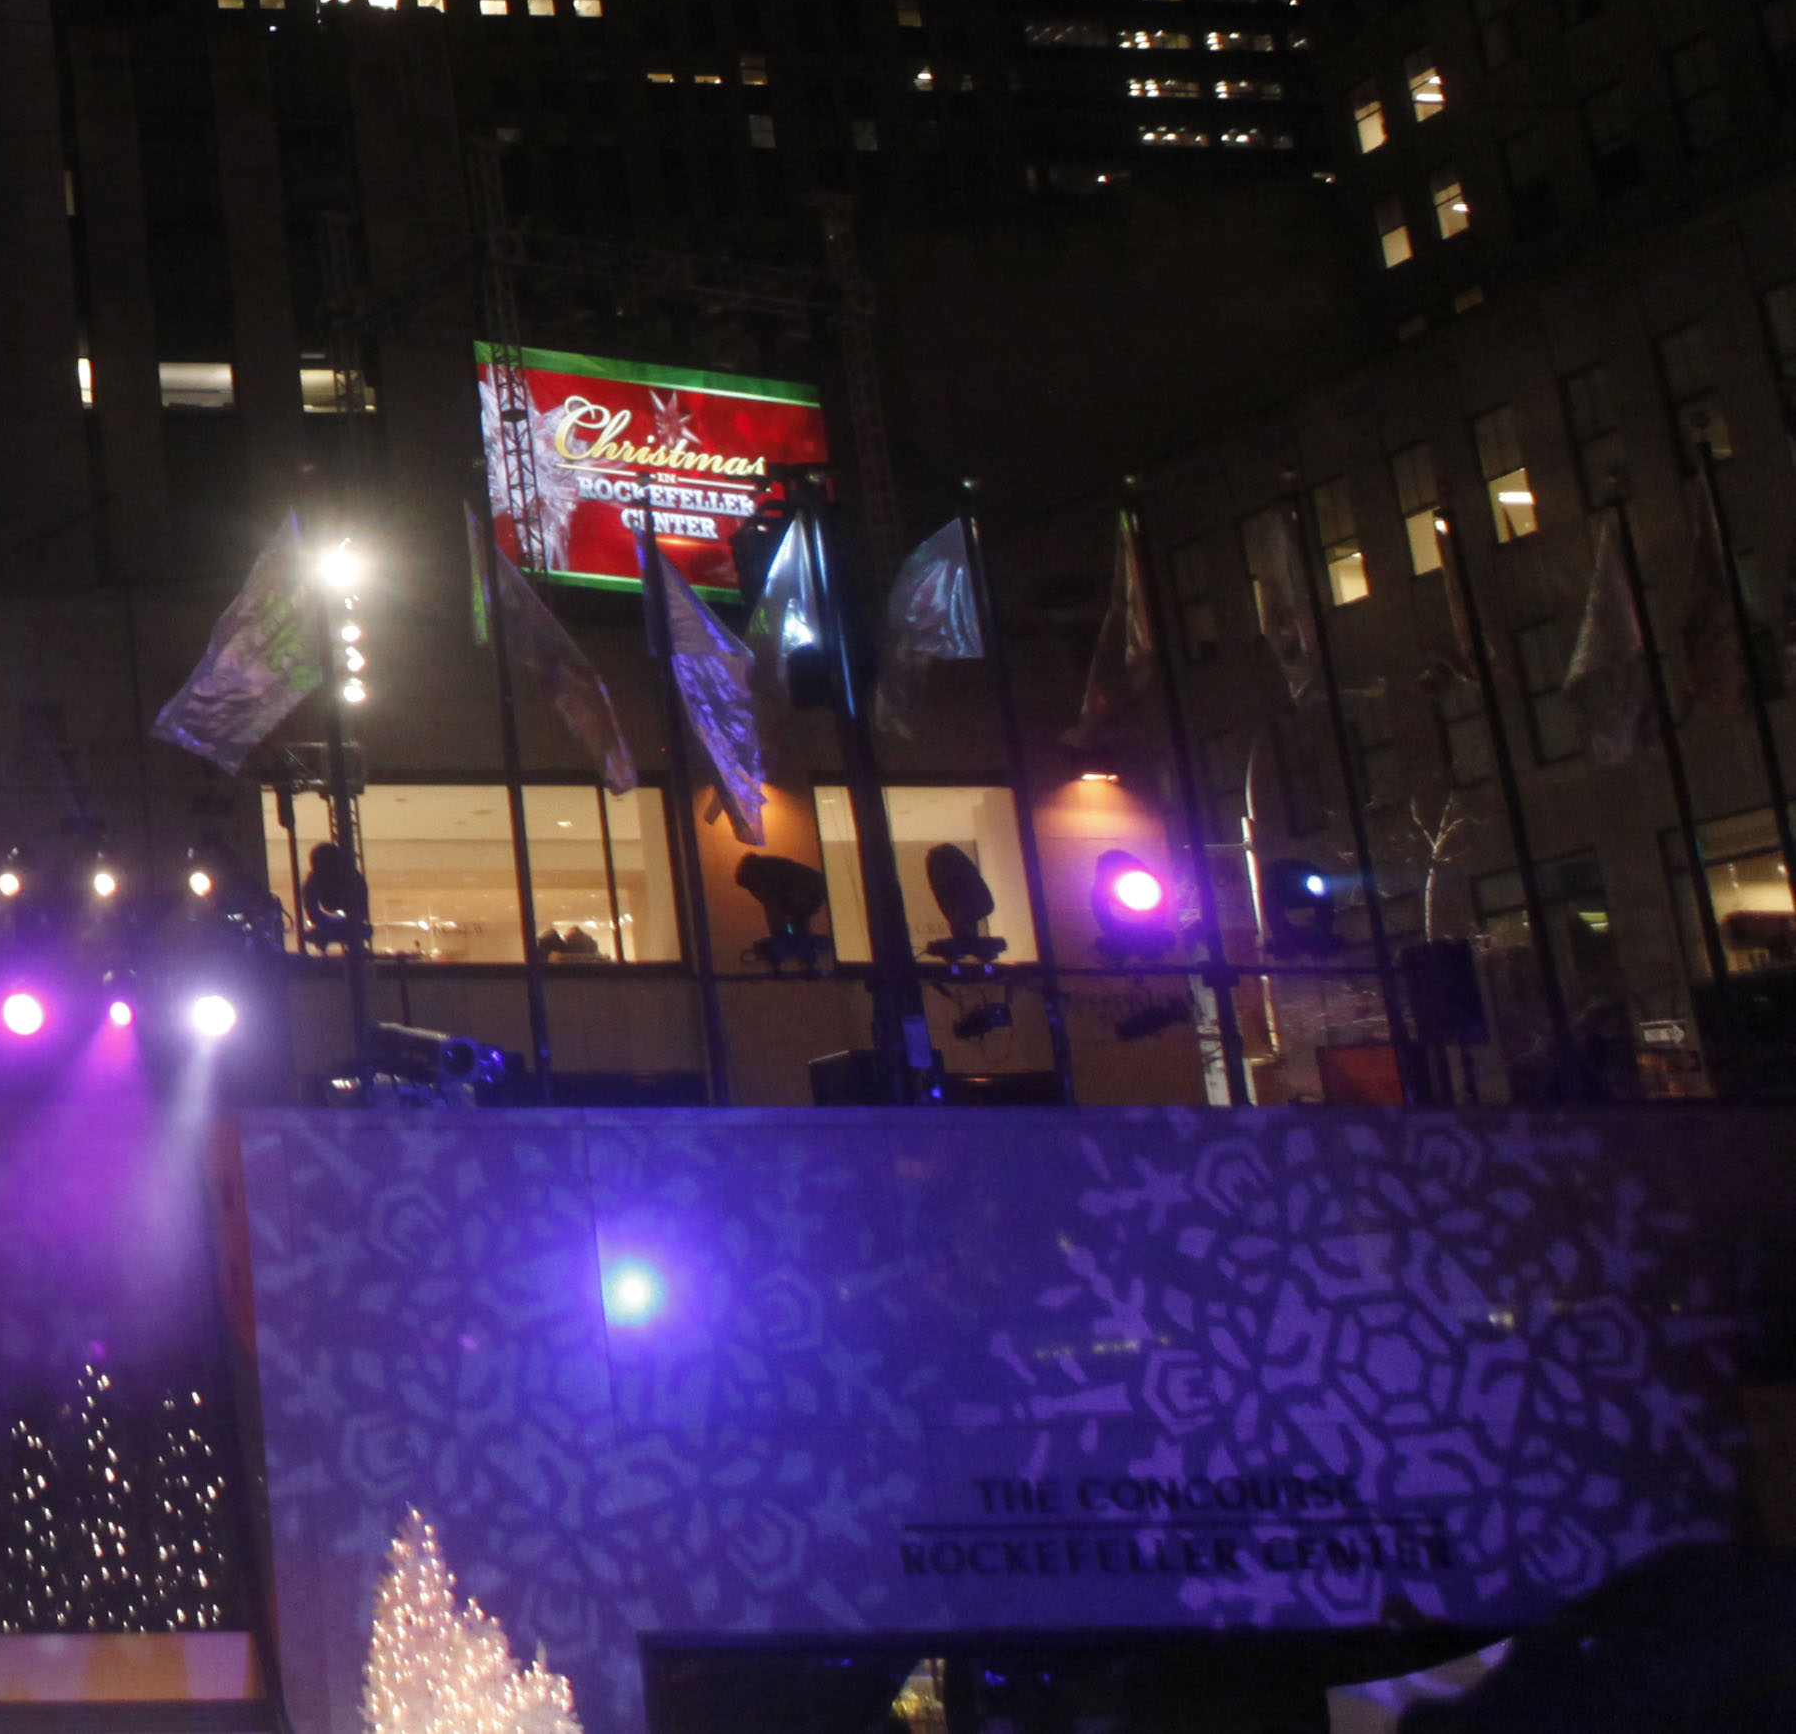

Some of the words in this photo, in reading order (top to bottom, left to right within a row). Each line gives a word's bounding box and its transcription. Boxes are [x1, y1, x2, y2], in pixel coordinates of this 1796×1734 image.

[554, 395, 766, 476] Christmas
[657, 472, 677, 484] IN
[971, 1476, 1063, 1513] THE
[1076, 1473, 1361, 1512] CONCOURSE
[900, 1536, 1239, 1578] ROCKEFELLER
[1259, 1532, 1455, 1573] CENTER
